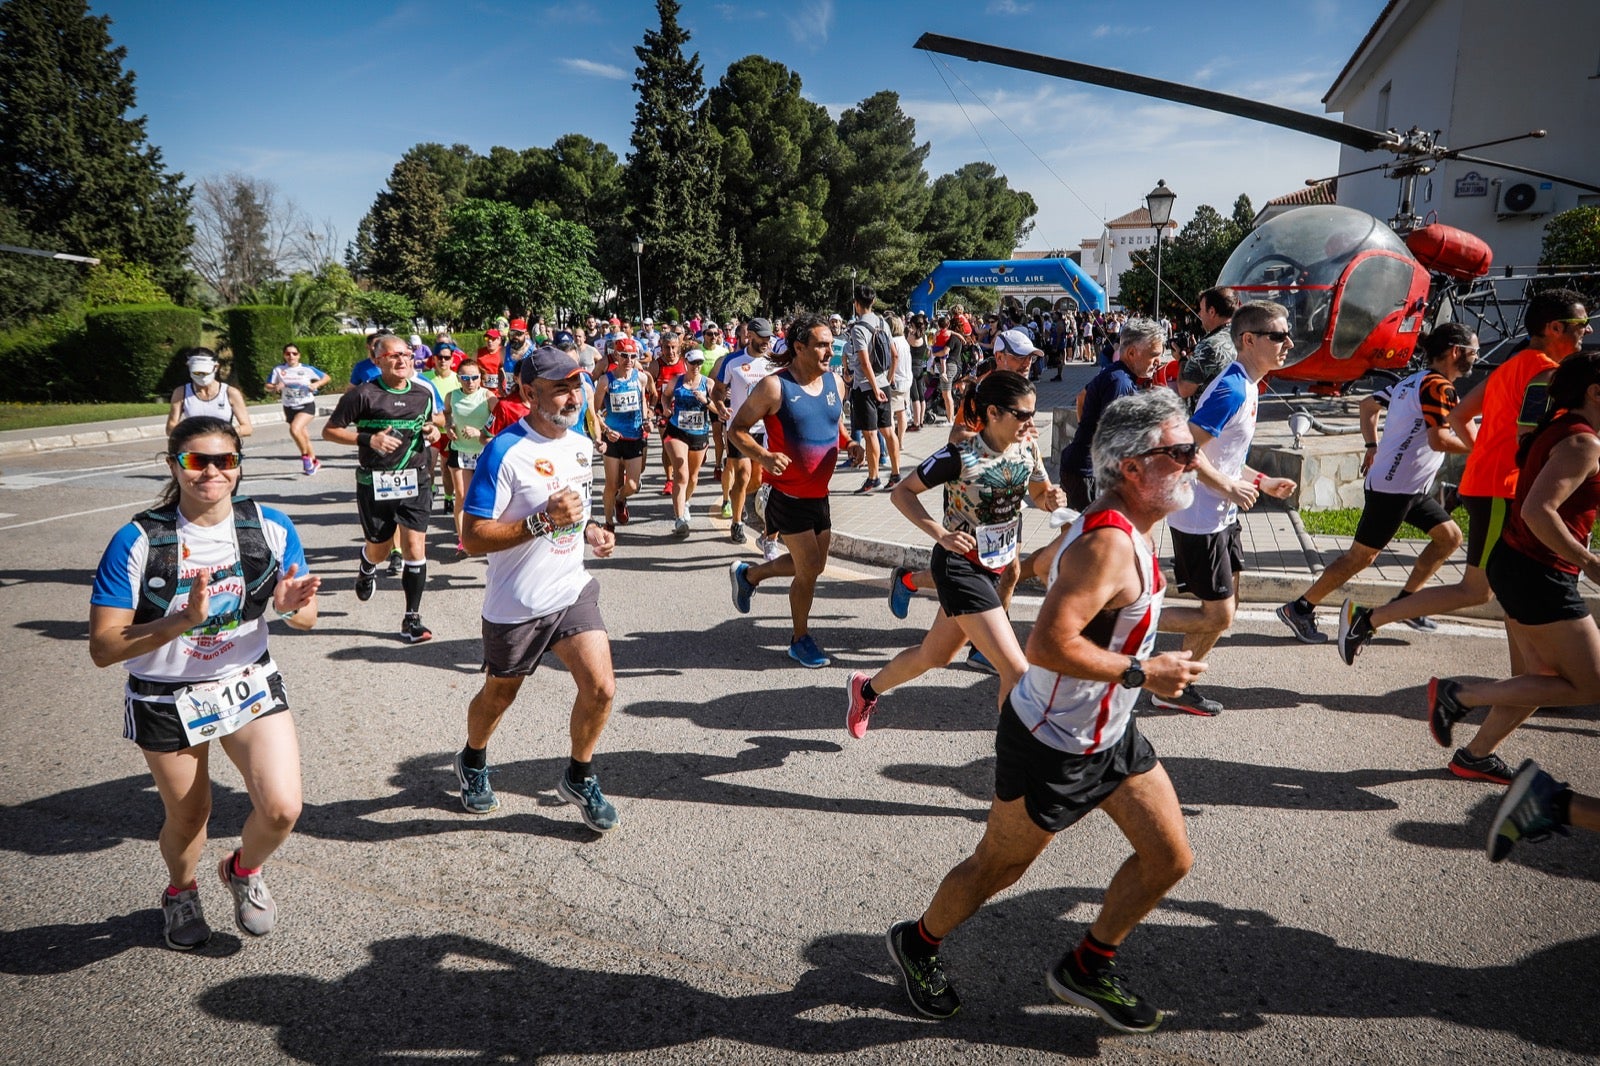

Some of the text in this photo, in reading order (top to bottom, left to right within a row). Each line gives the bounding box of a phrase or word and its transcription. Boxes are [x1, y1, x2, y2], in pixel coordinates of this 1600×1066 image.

[961, 275, 999, 283] EJÉRCITO
[620, 395, 636, 406] 217
[393, 476, 408, 487] 91
[193, 651, 203, 659] DE
[203, 651, 219, 660] MAYO
[221, 681, 250, 706] 10
